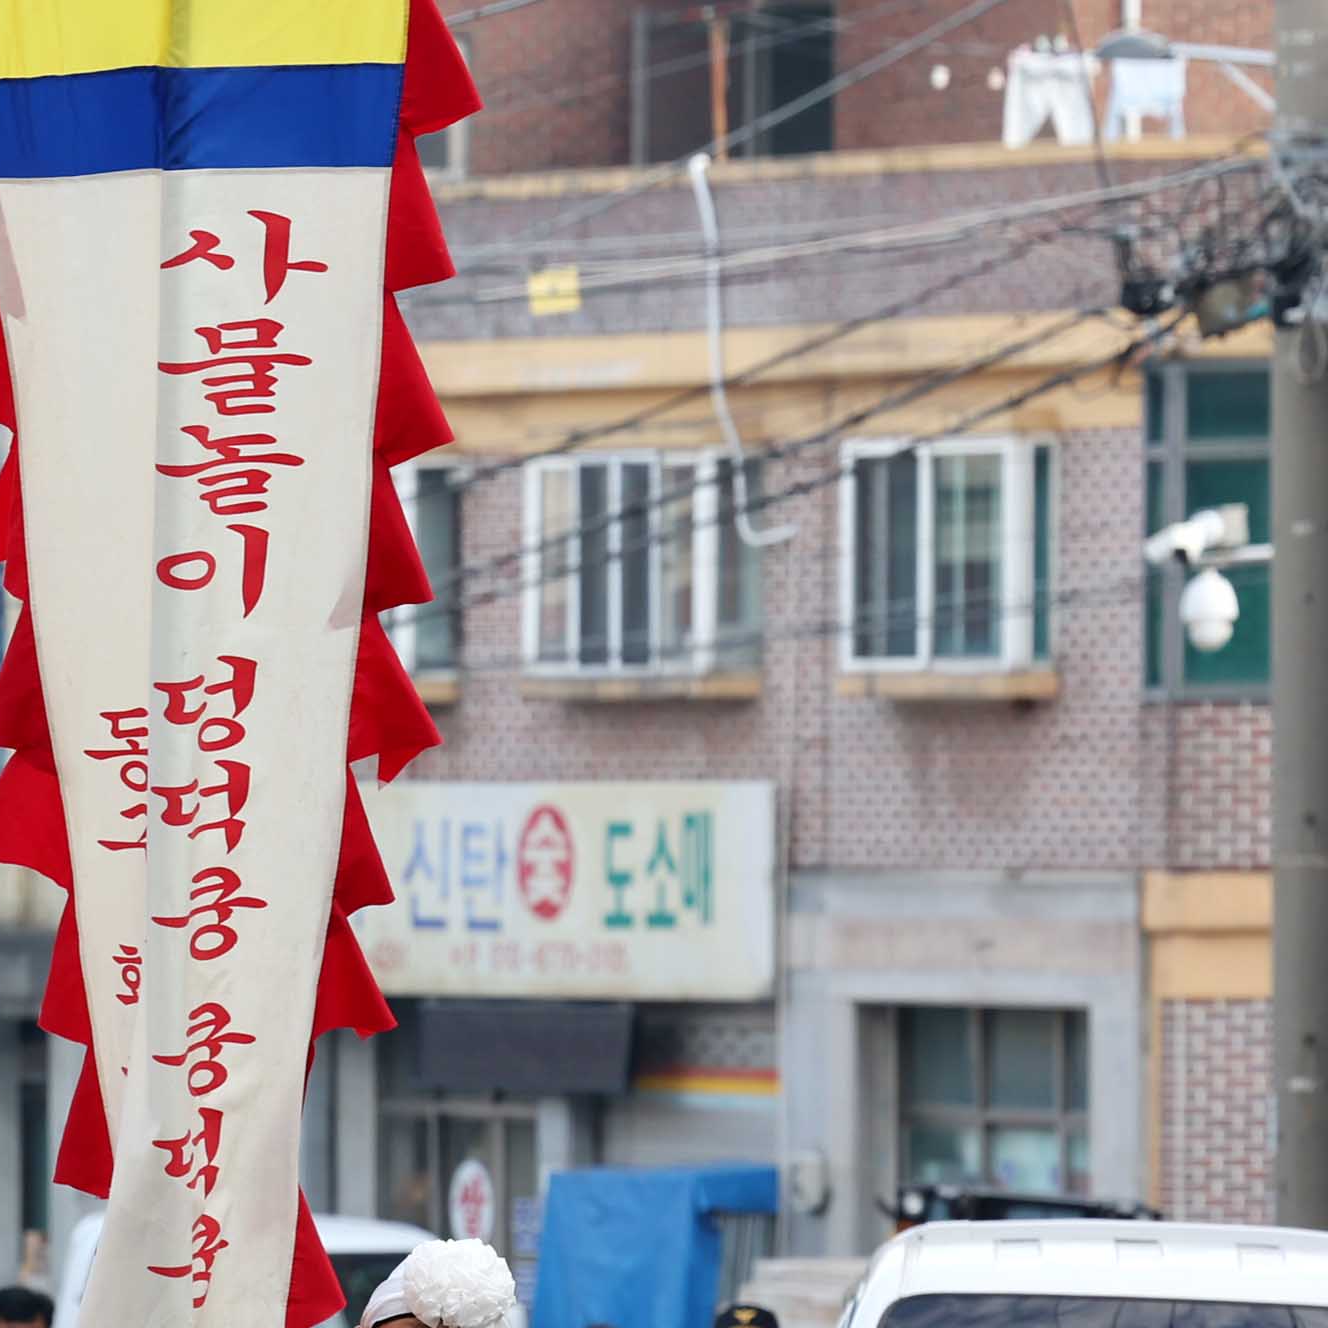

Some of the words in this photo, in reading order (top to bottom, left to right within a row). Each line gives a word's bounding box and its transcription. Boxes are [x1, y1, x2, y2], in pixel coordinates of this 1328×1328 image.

[157, 210, 328, 617] 사물놀이
[151, 655, 268, 961] 덩덕쿵
[401, 816, 508, 931] 신탄
[147, 1002, 257, 1309] 쿵덕쿵
